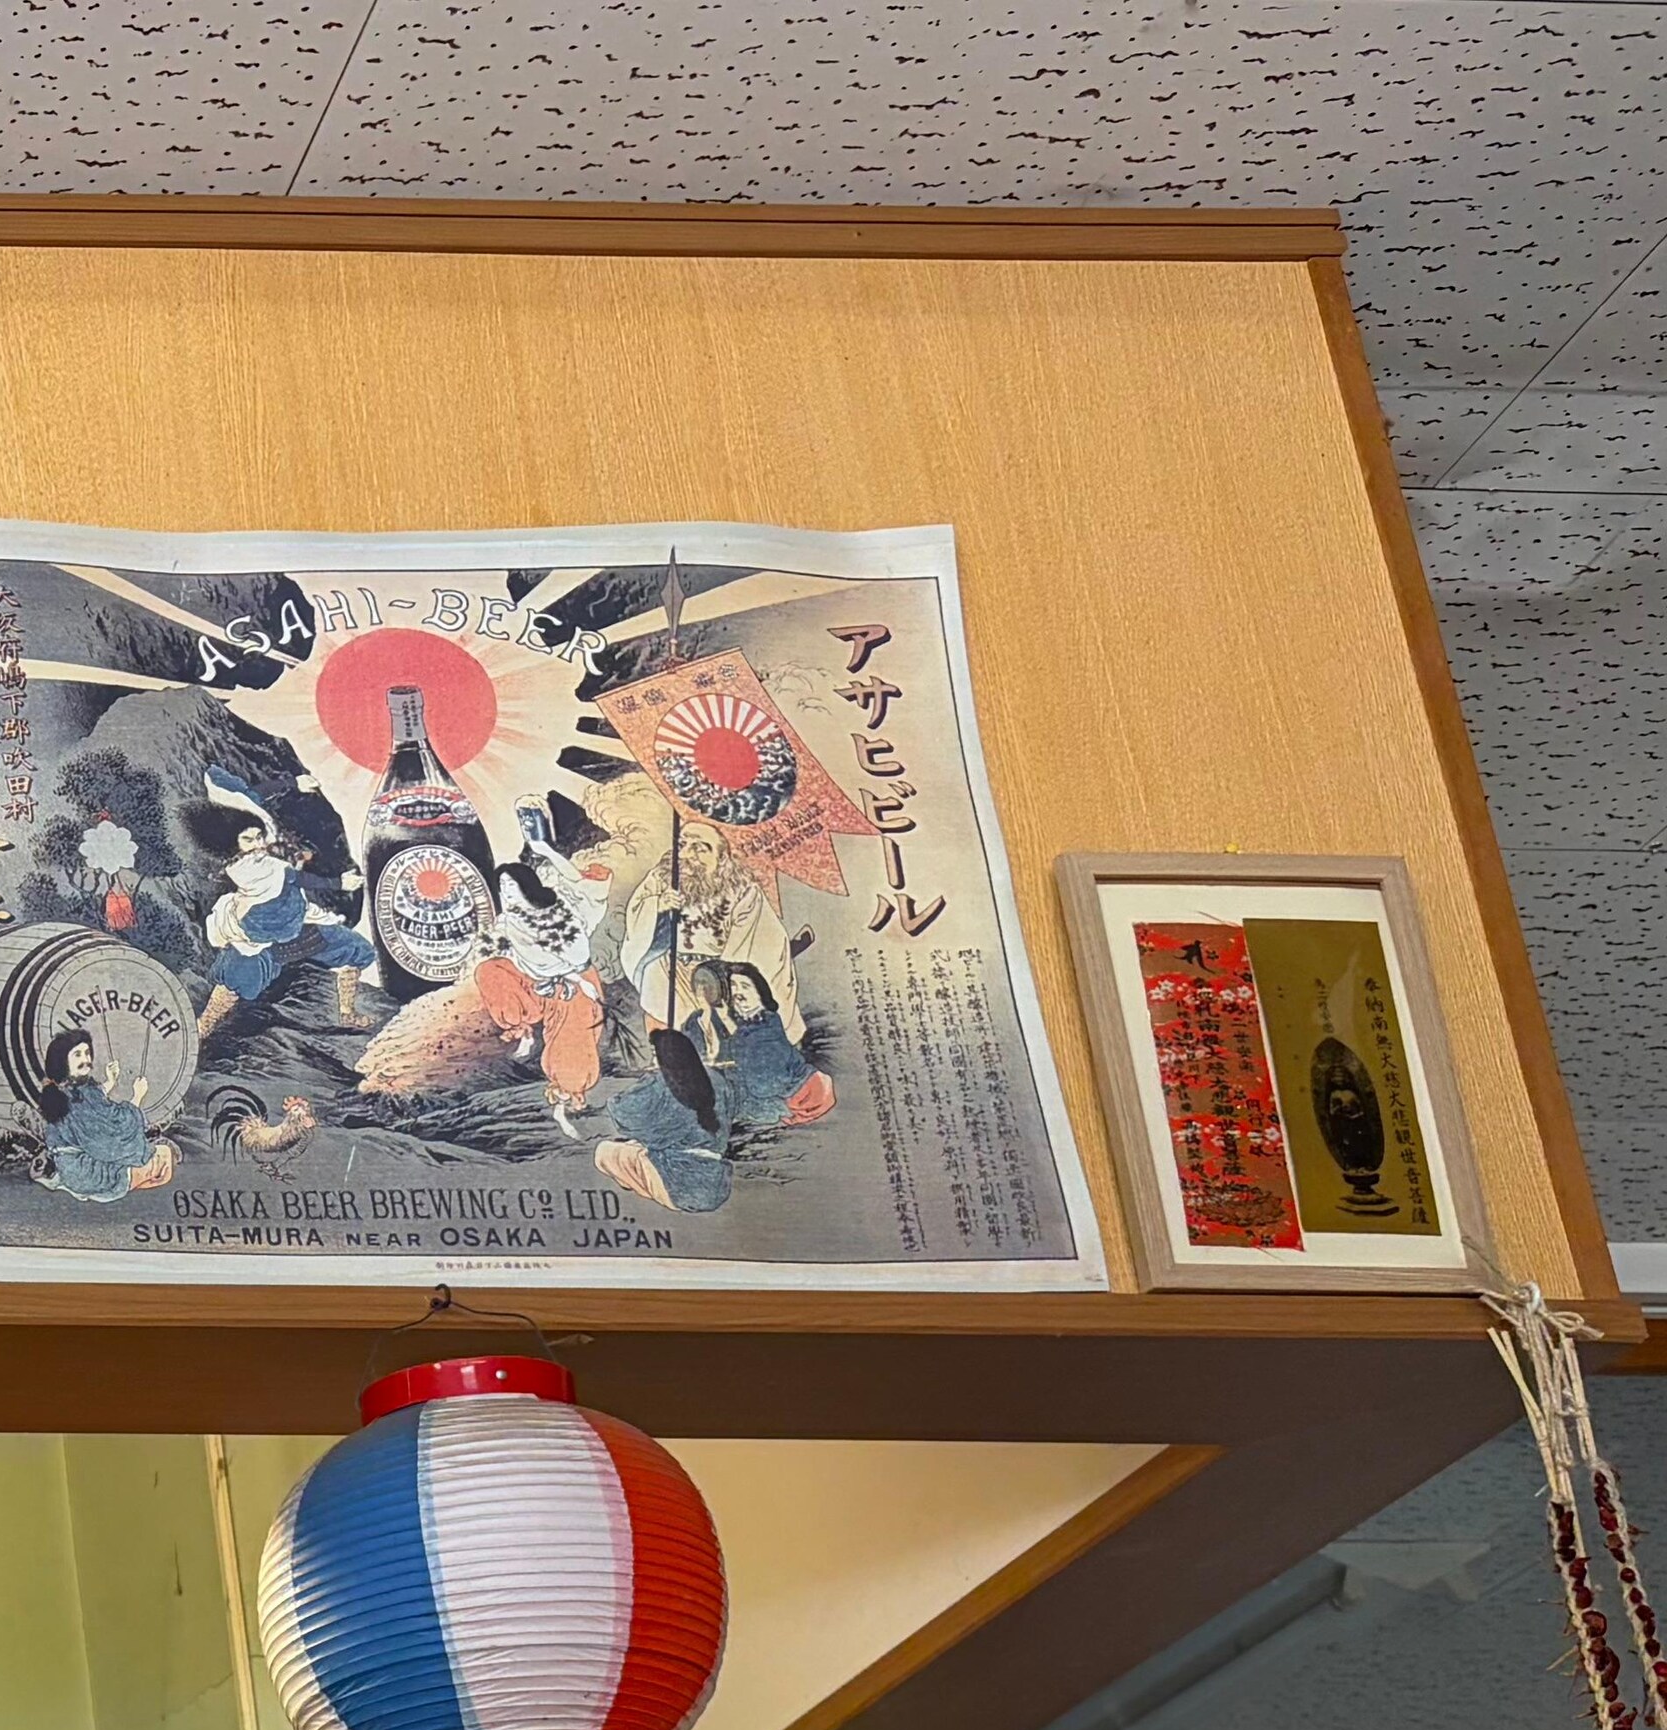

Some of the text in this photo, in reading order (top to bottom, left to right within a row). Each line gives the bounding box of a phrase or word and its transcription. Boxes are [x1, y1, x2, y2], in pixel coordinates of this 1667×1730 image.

[196, 587, 609, 682] ASAHI-BEER
[827, 624, 947, 938] アサヒビール
[133, 1223, 674, 1250] SUITA-MURA NEAR OSAKA JAPAN
[174, 1191, 267, 1221] OSAKA
[281, 1190, 363, 1221] BEER
[370, 1189, 509, 1221] BREWING
